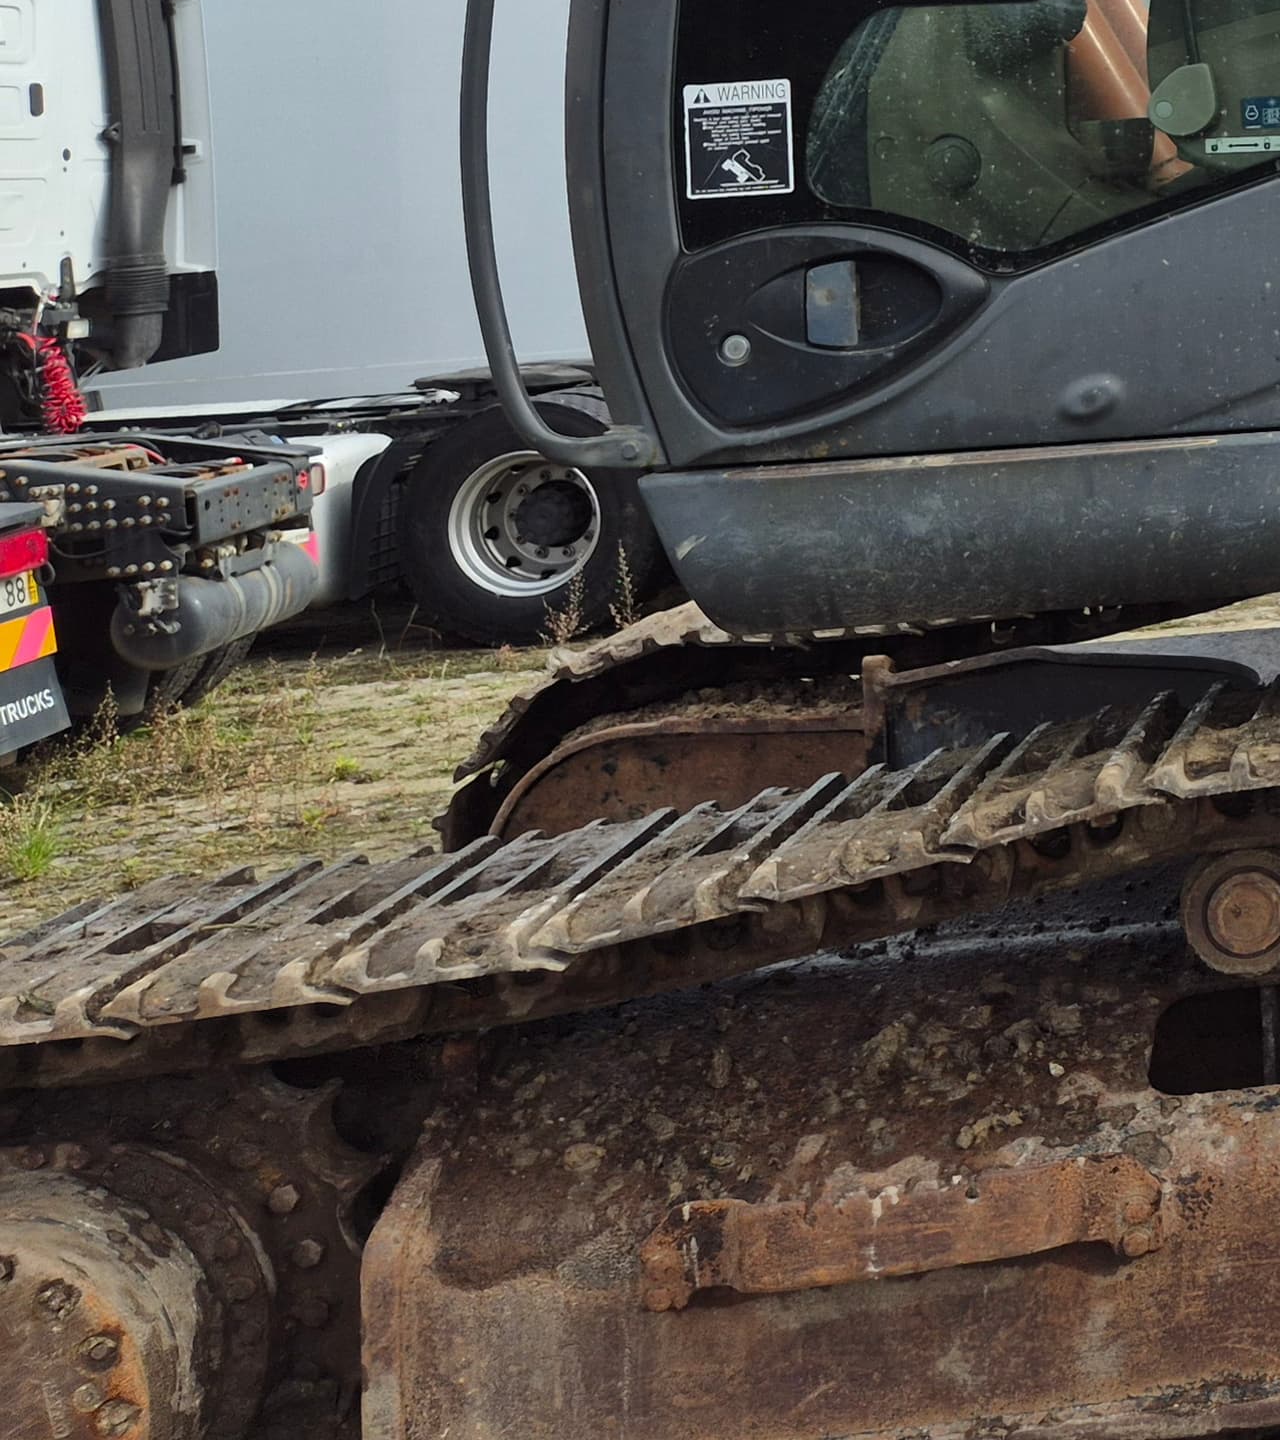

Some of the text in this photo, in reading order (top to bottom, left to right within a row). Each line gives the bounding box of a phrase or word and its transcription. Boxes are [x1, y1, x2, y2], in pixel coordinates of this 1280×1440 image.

[717, 83, 786, 101] WARNING
[5, 576, 25, 607] 88
[0, 689, 54, 725] TRUCKS
